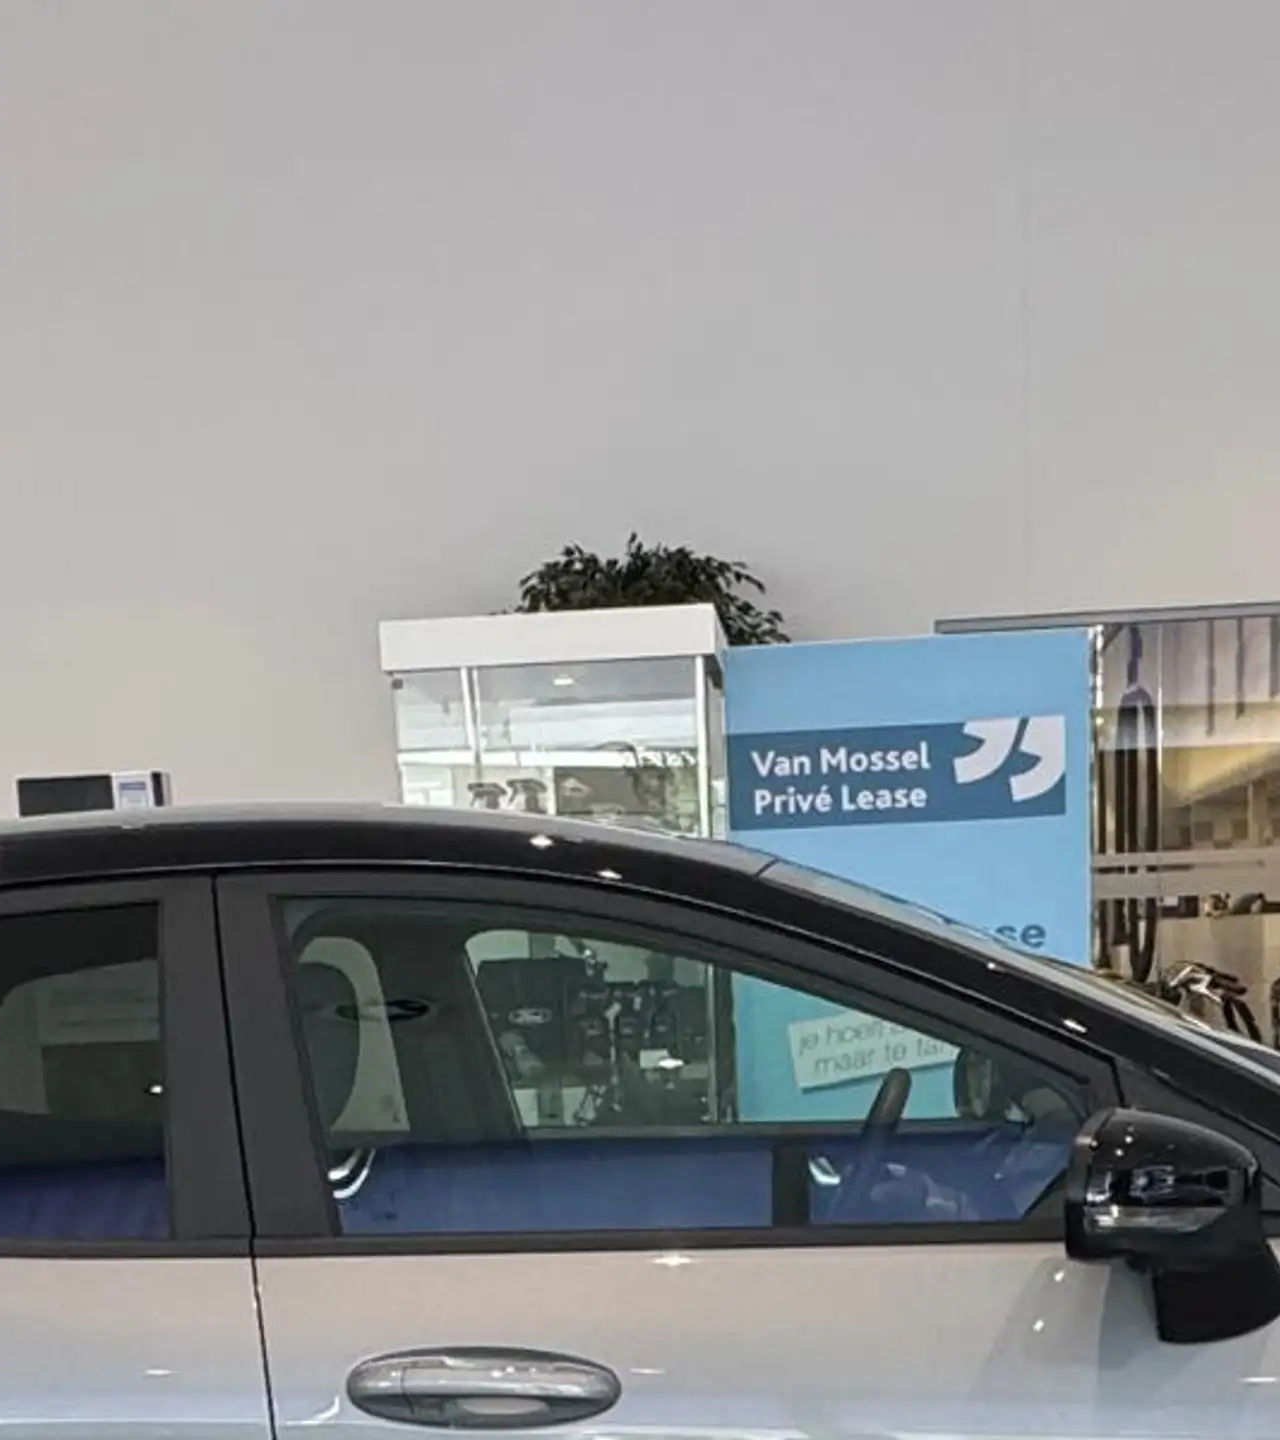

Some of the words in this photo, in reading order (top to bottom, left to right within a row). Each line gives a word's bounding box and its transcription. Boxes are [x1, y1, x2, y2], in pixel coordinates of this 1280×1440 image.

[750, 751, 812, 777] Van
[819, 741, 932, 773] Mossel
[753, 785, 833, 815] Privé
[841, 785, 928, 811] Lease
